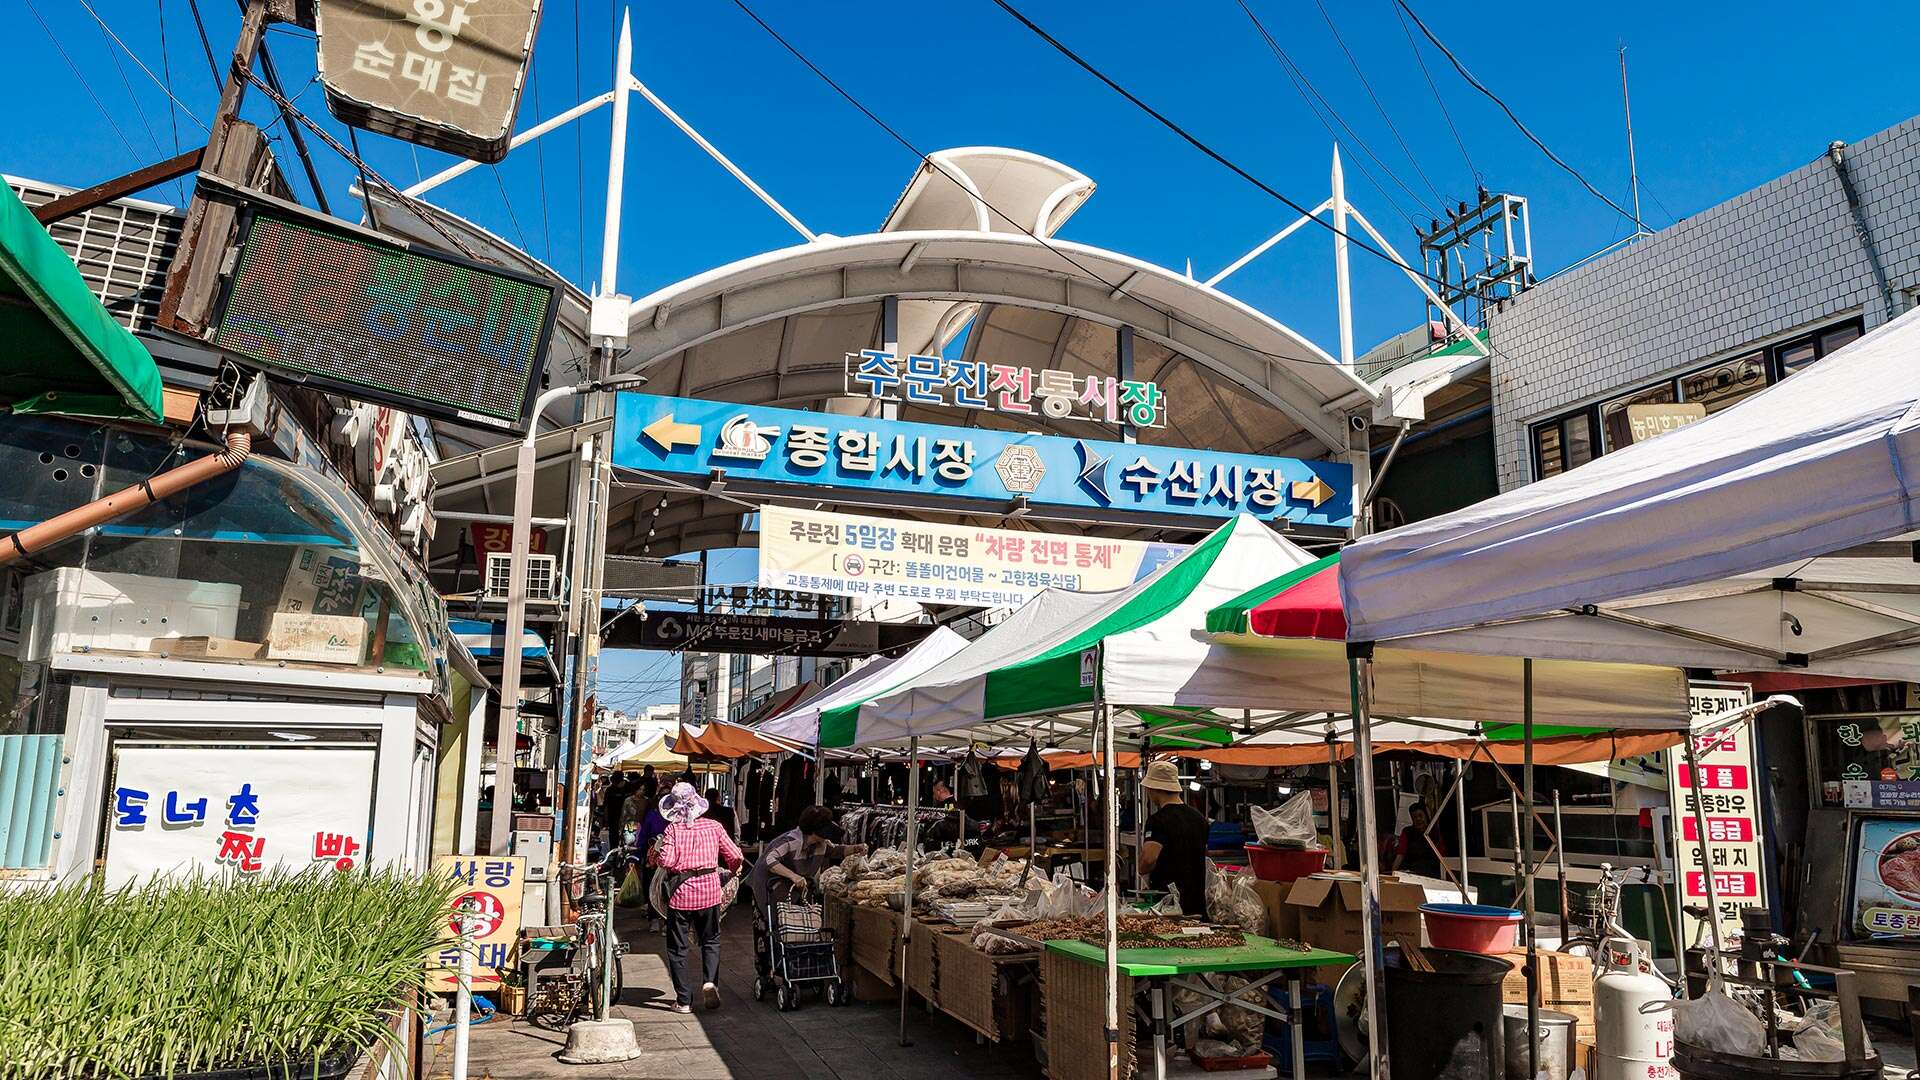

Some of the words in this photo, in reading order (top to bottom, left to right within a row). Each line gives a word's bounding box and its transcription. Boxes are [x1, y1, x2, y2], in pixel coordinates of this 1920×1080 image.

[413, 0, 470, 52] 왕
[353, 41, 488, 106] 순대집
[855, 349, 1163, 426] 주문진전통시장
[788, 424, 977, 481] 종합시장
[1125, 455, 1286, 508] 수산시장
[789, 520, 840, 546] 주문진
[845, 524, 897, 552] 5일장
[901, 531, 933, 555] 확대
[938, 536, 969, 558] 운영
[1030, 539, 1068, 566] 전면
[786, 573, 844, 590] 교통통제에
[847, 581, 869, 594] 따라
[872, 582, 895, 597] 주변
[899, 585, 931, 599] 도로로
[934, 588, 956, 601] 우회
[959, 589, 1024, 605] 부탁드립니다
[450, 861, 515, 888] 사랑
